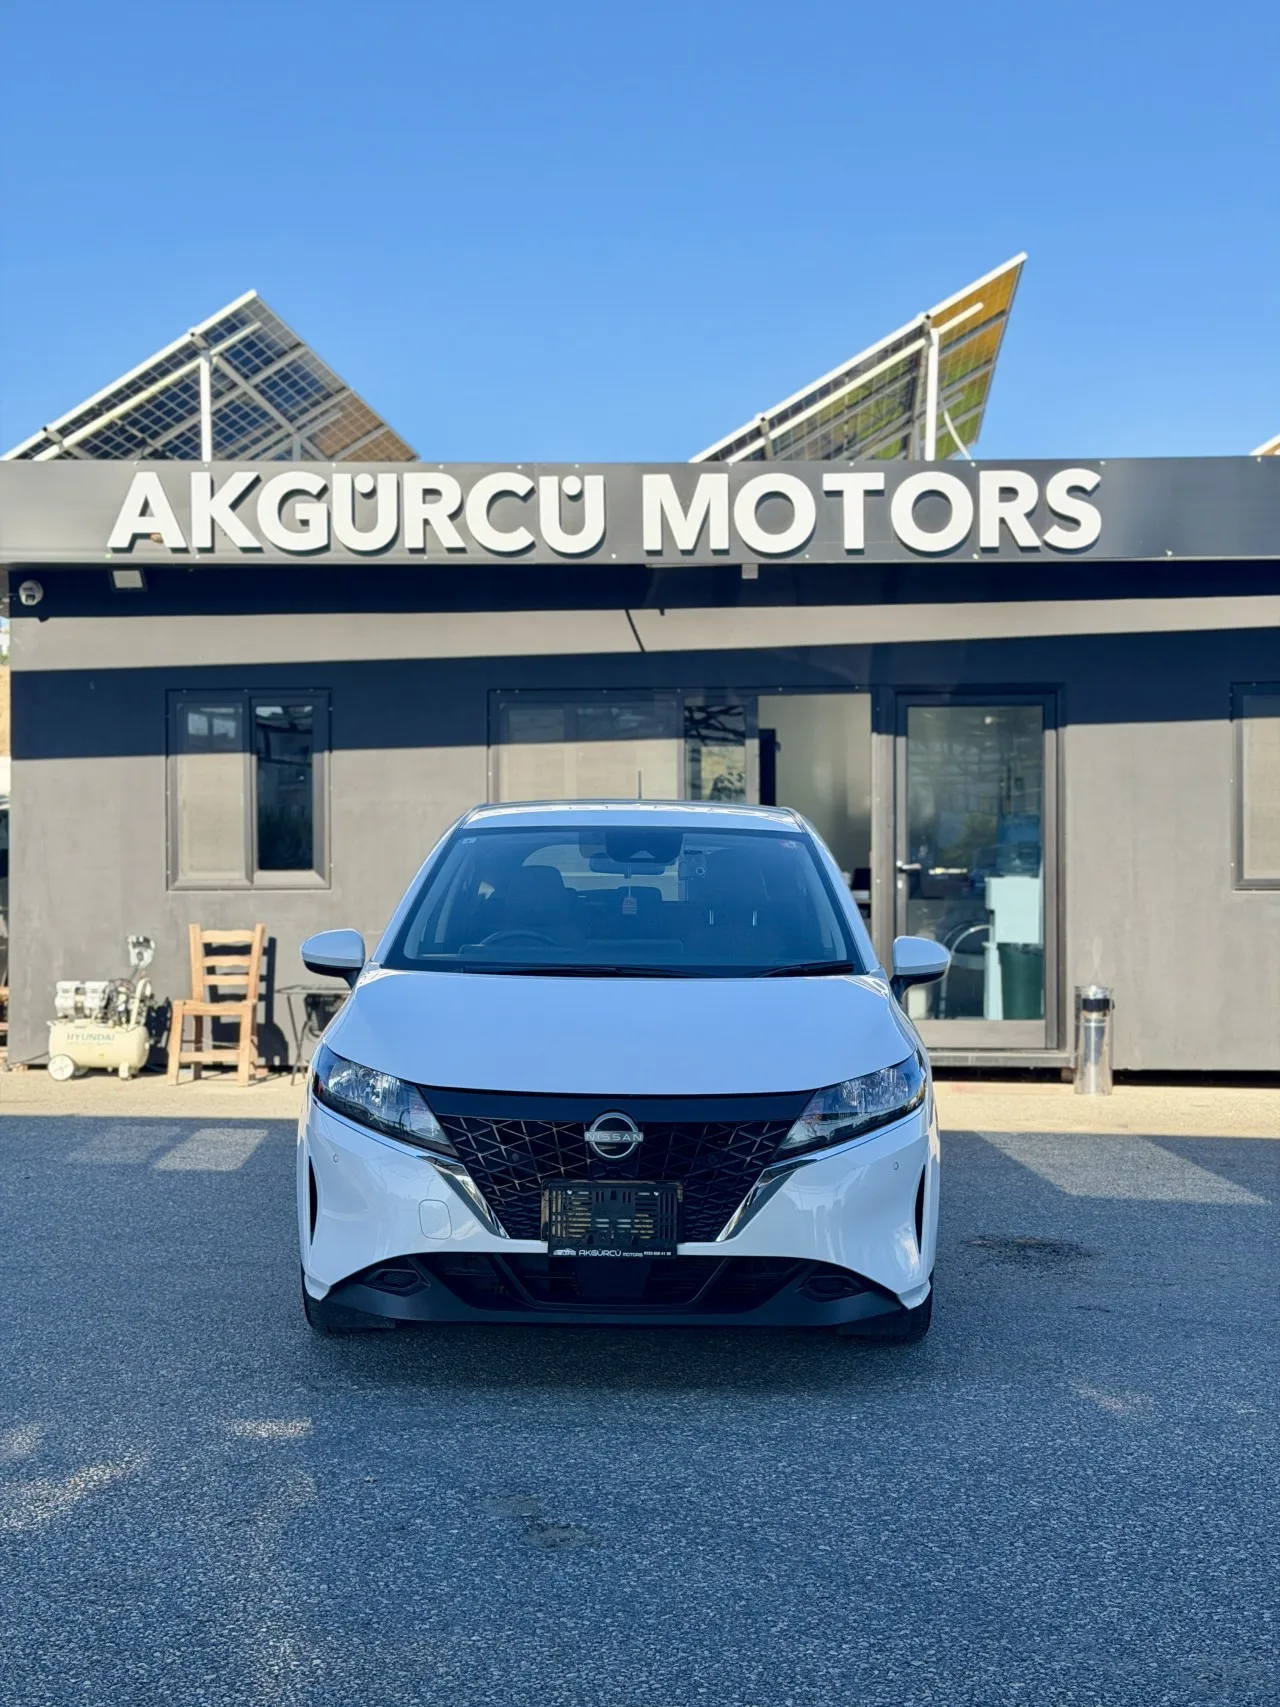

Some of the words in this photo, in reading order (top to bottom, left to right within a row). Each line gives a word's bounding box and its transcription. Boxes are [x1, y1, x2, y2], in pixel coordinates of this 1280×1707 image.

[642, 468, 1101, 554] MOTORS
[67, 1033, 115, 1041] HYUNDAI
[586, 1133, 643, 1141] NISSAN
